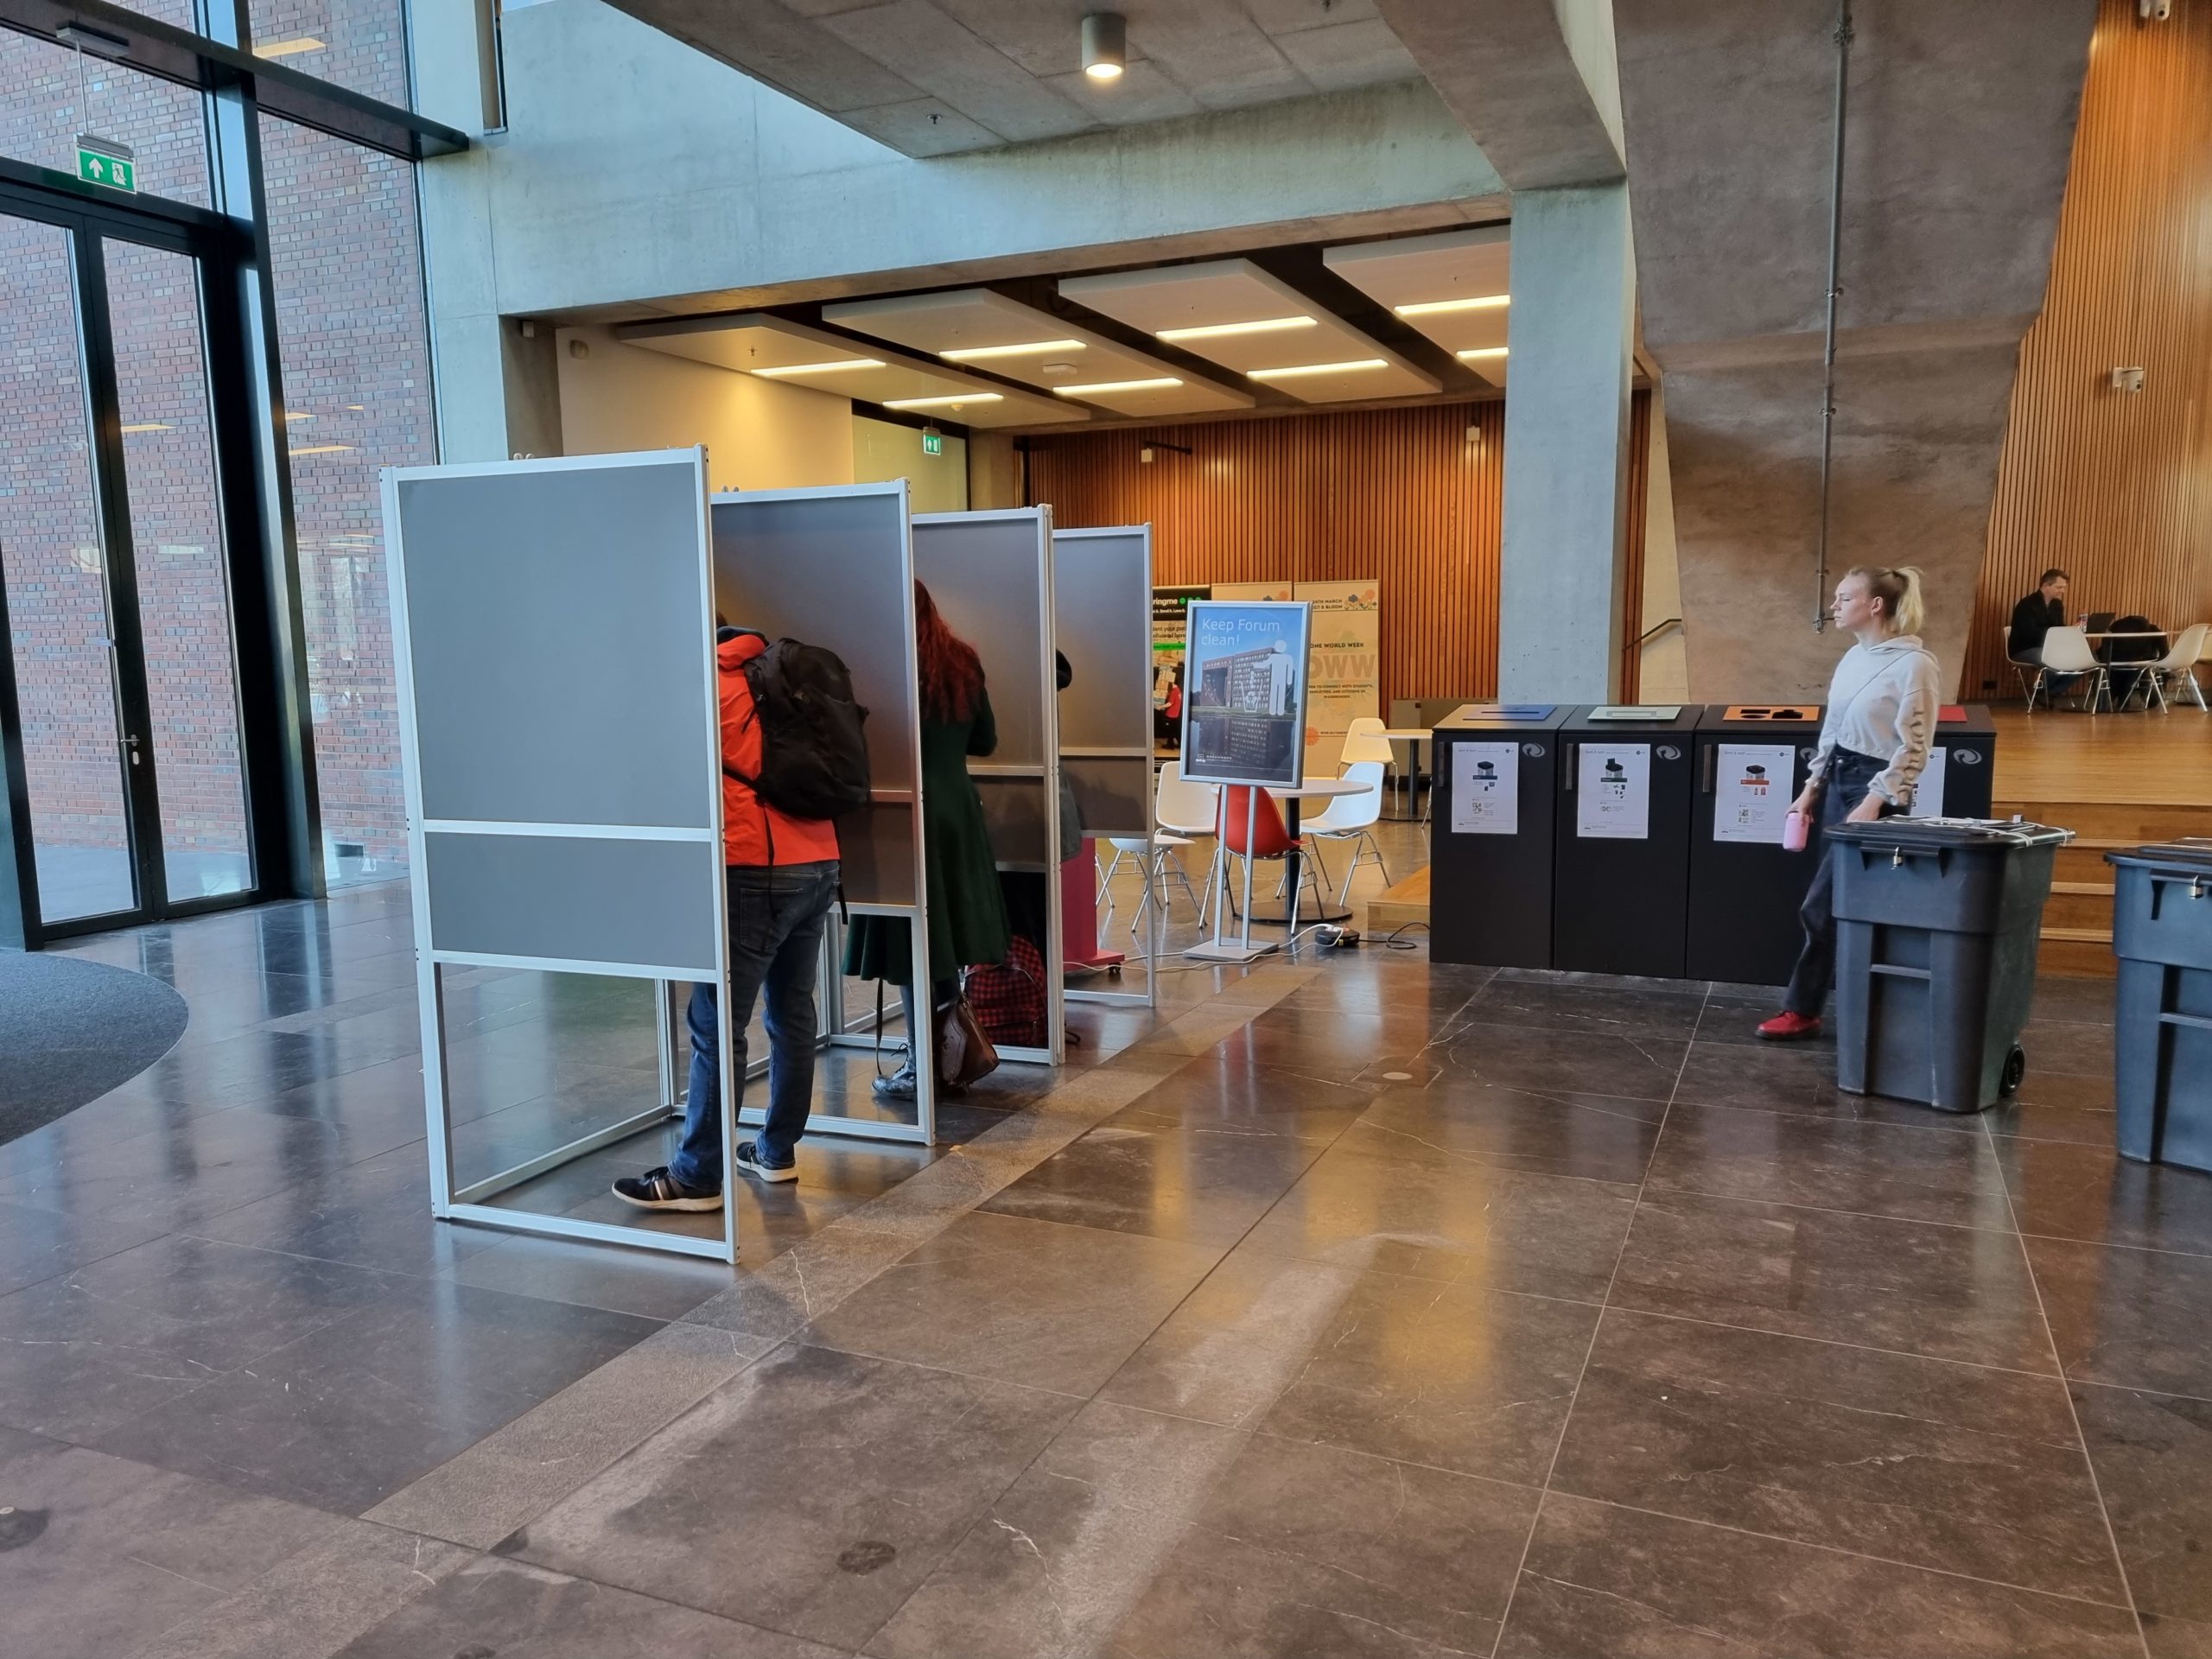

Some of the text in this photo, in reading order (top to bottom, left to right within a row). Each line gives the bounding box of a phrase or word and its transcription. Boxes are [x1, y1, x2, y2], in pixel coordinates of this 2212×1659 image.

[1153, 597, 1179, 607] ringme
[1202, 618, 1280, 632] Keep Forum
[1201, 634, 1239, 646] clean!
